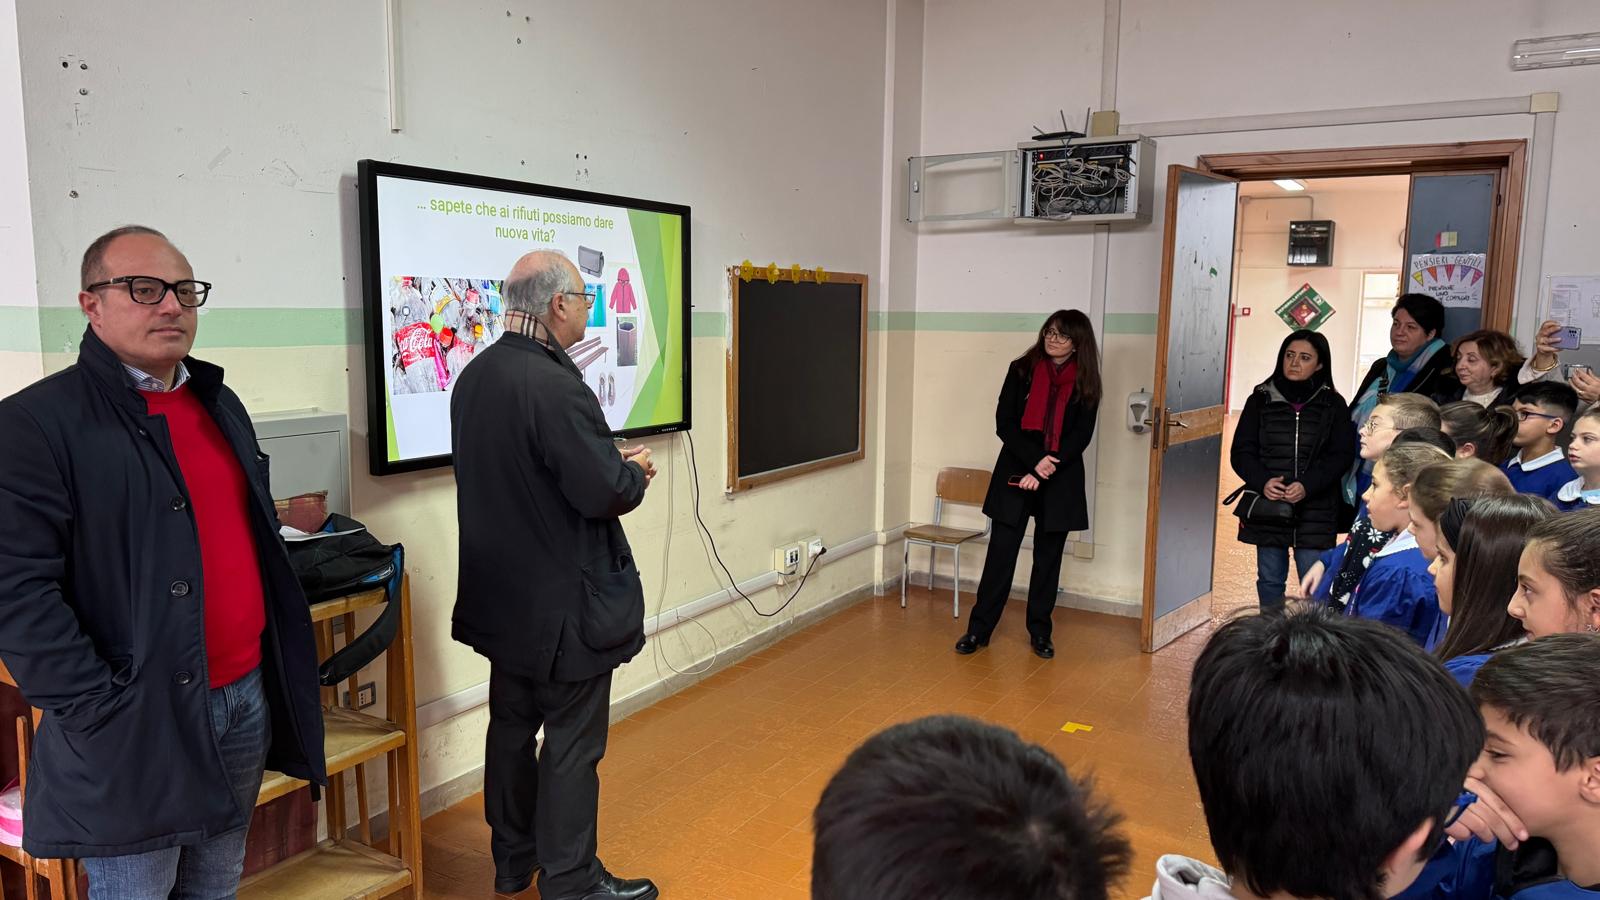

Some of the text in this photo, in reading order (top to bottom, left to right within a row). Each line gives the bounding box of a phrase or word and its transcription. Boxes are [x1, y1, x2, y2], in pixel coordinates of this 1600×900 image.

[430, 199, 473, 215] sapete
[475, 202, 497, 217] che
[500, 205, 510, 218] ai
[513, 206, 540, 222] rifiuti
[543, 210, 592, 228] possiamo
[594, 215, 614, 230] dare
[495, 225, 556, 243] nuova vita?
[1414, 256, 1482, 269] PENSIERI GENTILI
